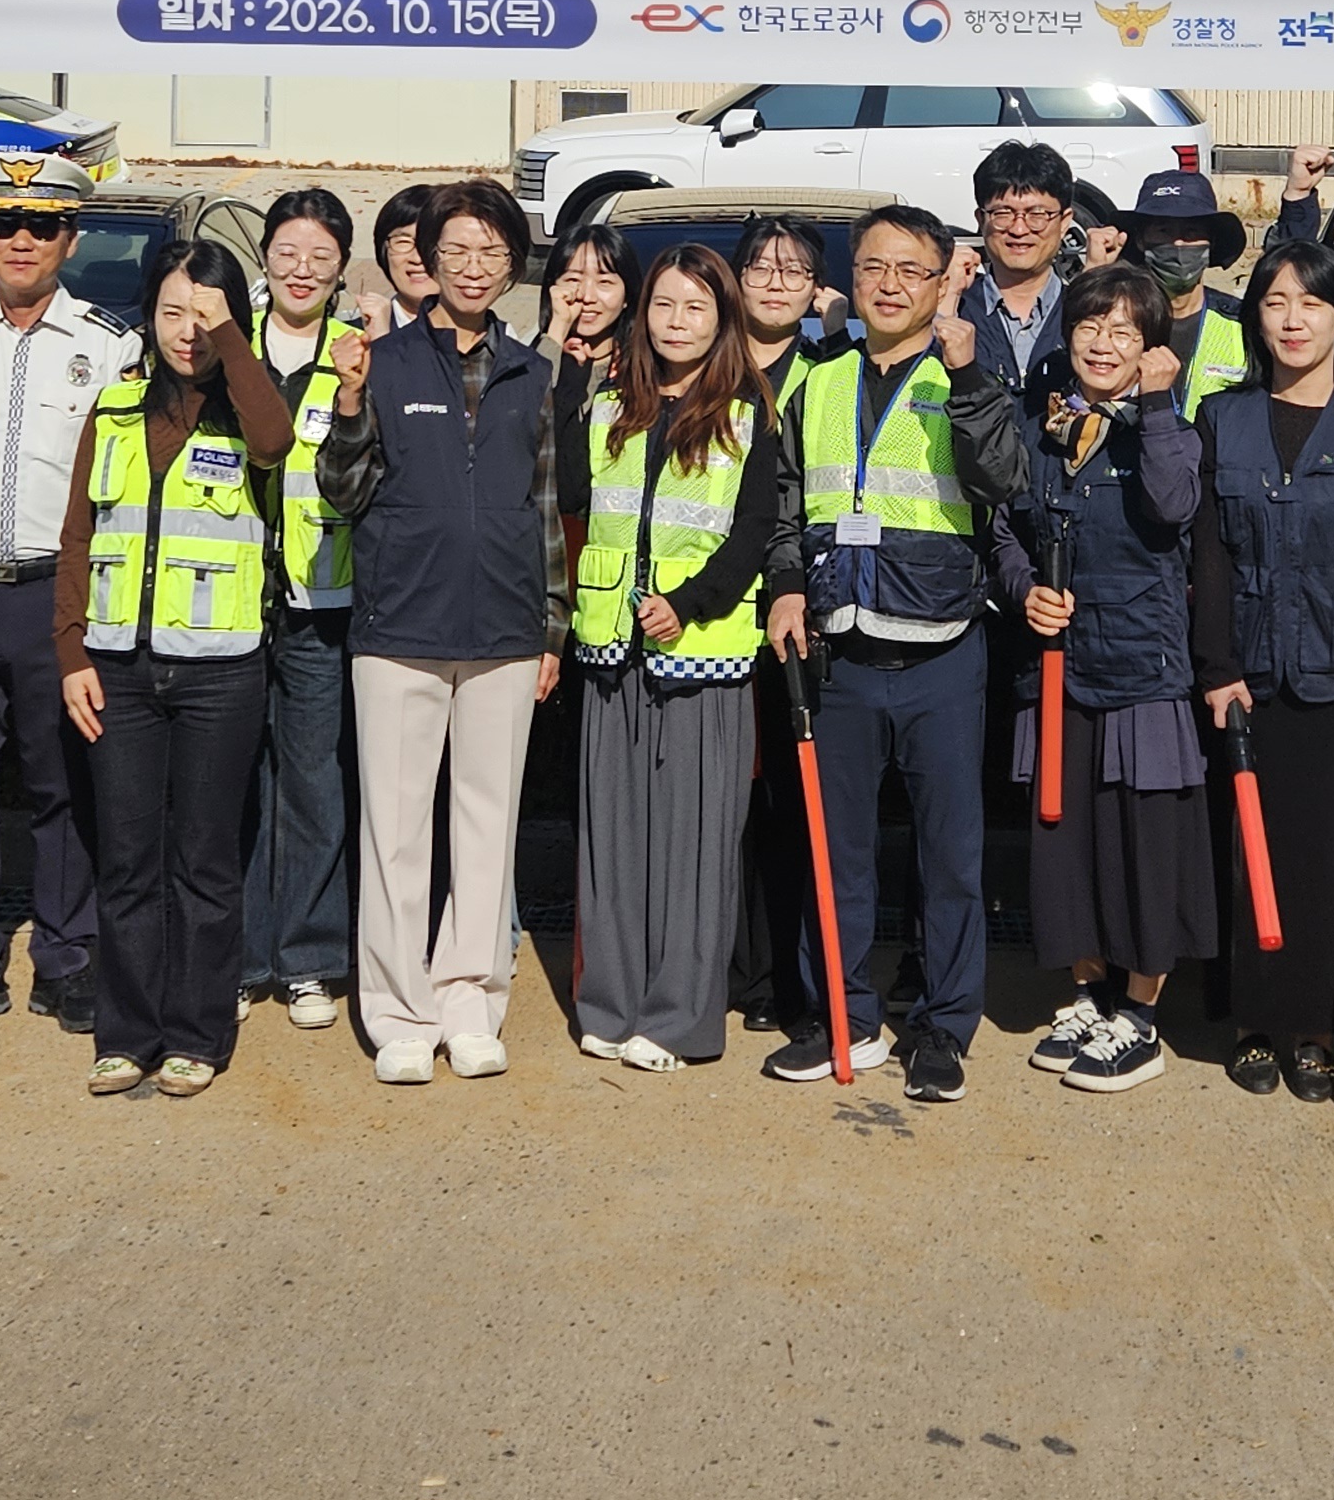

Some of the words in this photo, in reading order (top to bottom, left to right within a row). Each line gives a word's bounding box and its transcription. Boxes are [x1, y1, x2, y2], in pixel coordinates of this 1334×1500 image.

[386, 0, 436, 33] 10.
[448, 0, 555, 37] 15(목)
[739, 6, 883, 34] 한국도로공사
[965, 10, 1082, 34] 행정안전부
[1173, 18, 1235, 40] 경찰청
[196, 450, 236, 465] POLICE
